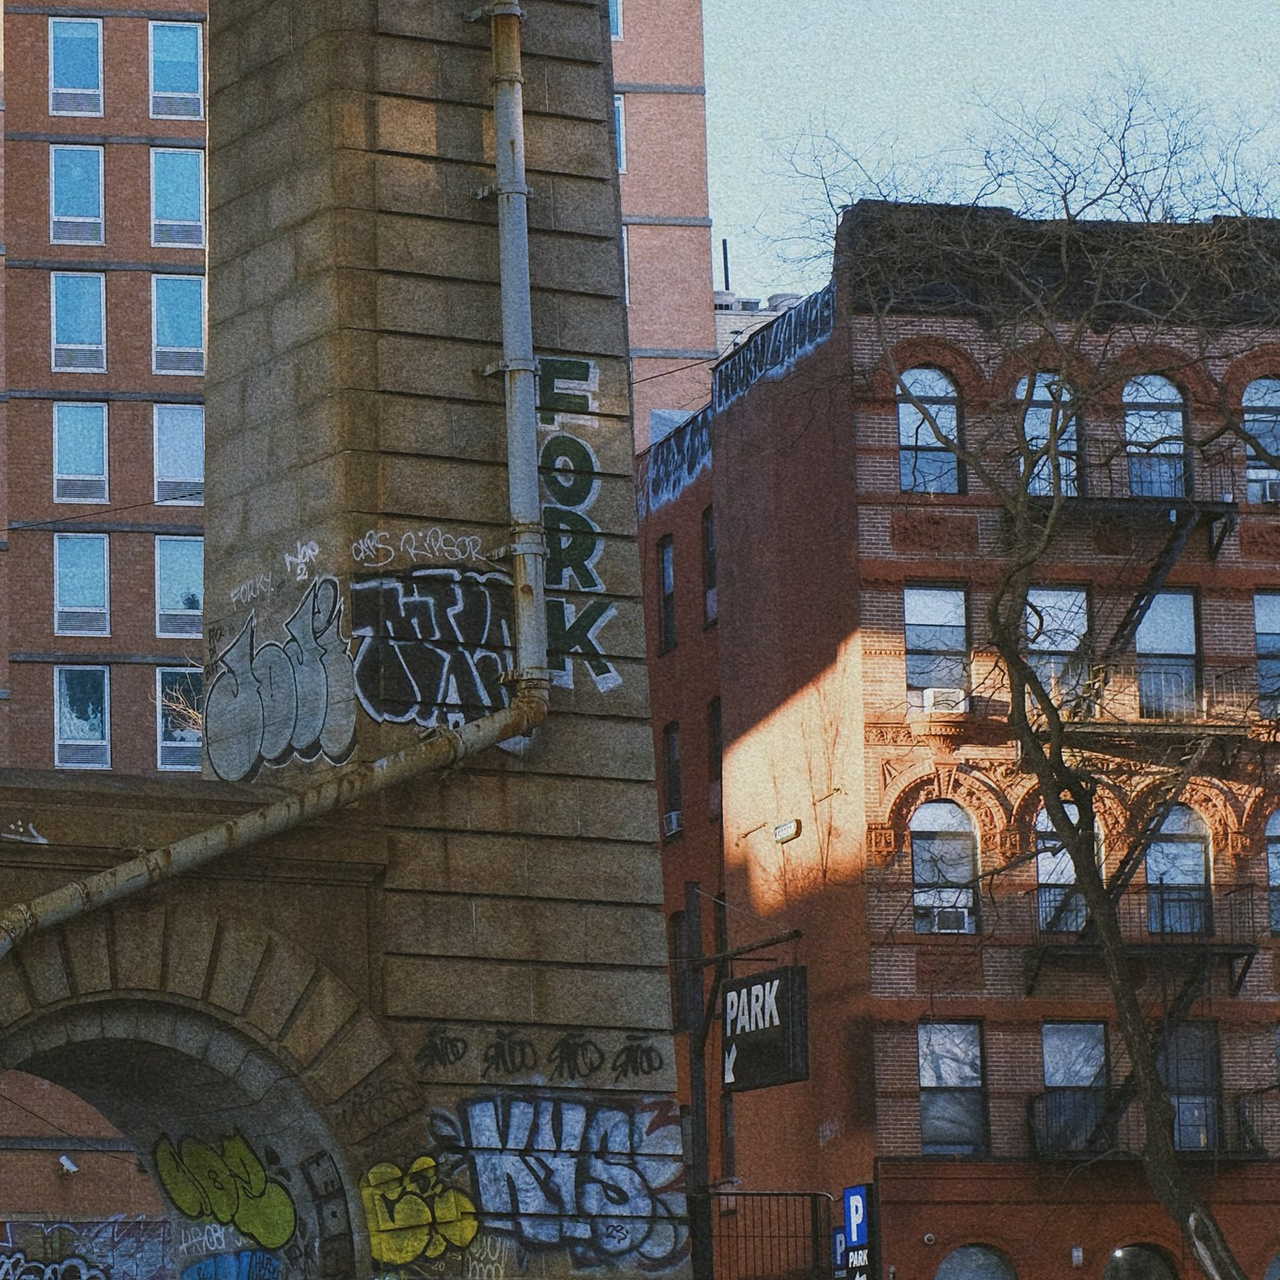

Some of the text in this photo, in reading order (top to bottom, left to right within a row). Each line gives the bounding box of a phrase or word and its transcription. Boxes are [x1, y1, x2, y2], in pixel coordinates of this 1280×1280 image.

[537, 356, 622, 693] FORK
[725, 978, 781, 1038] PARK
[849, 1194, 864, 1242] P
[836, 1232, 846, 1266] P
[848, 1248, 869, 1269] PARK
